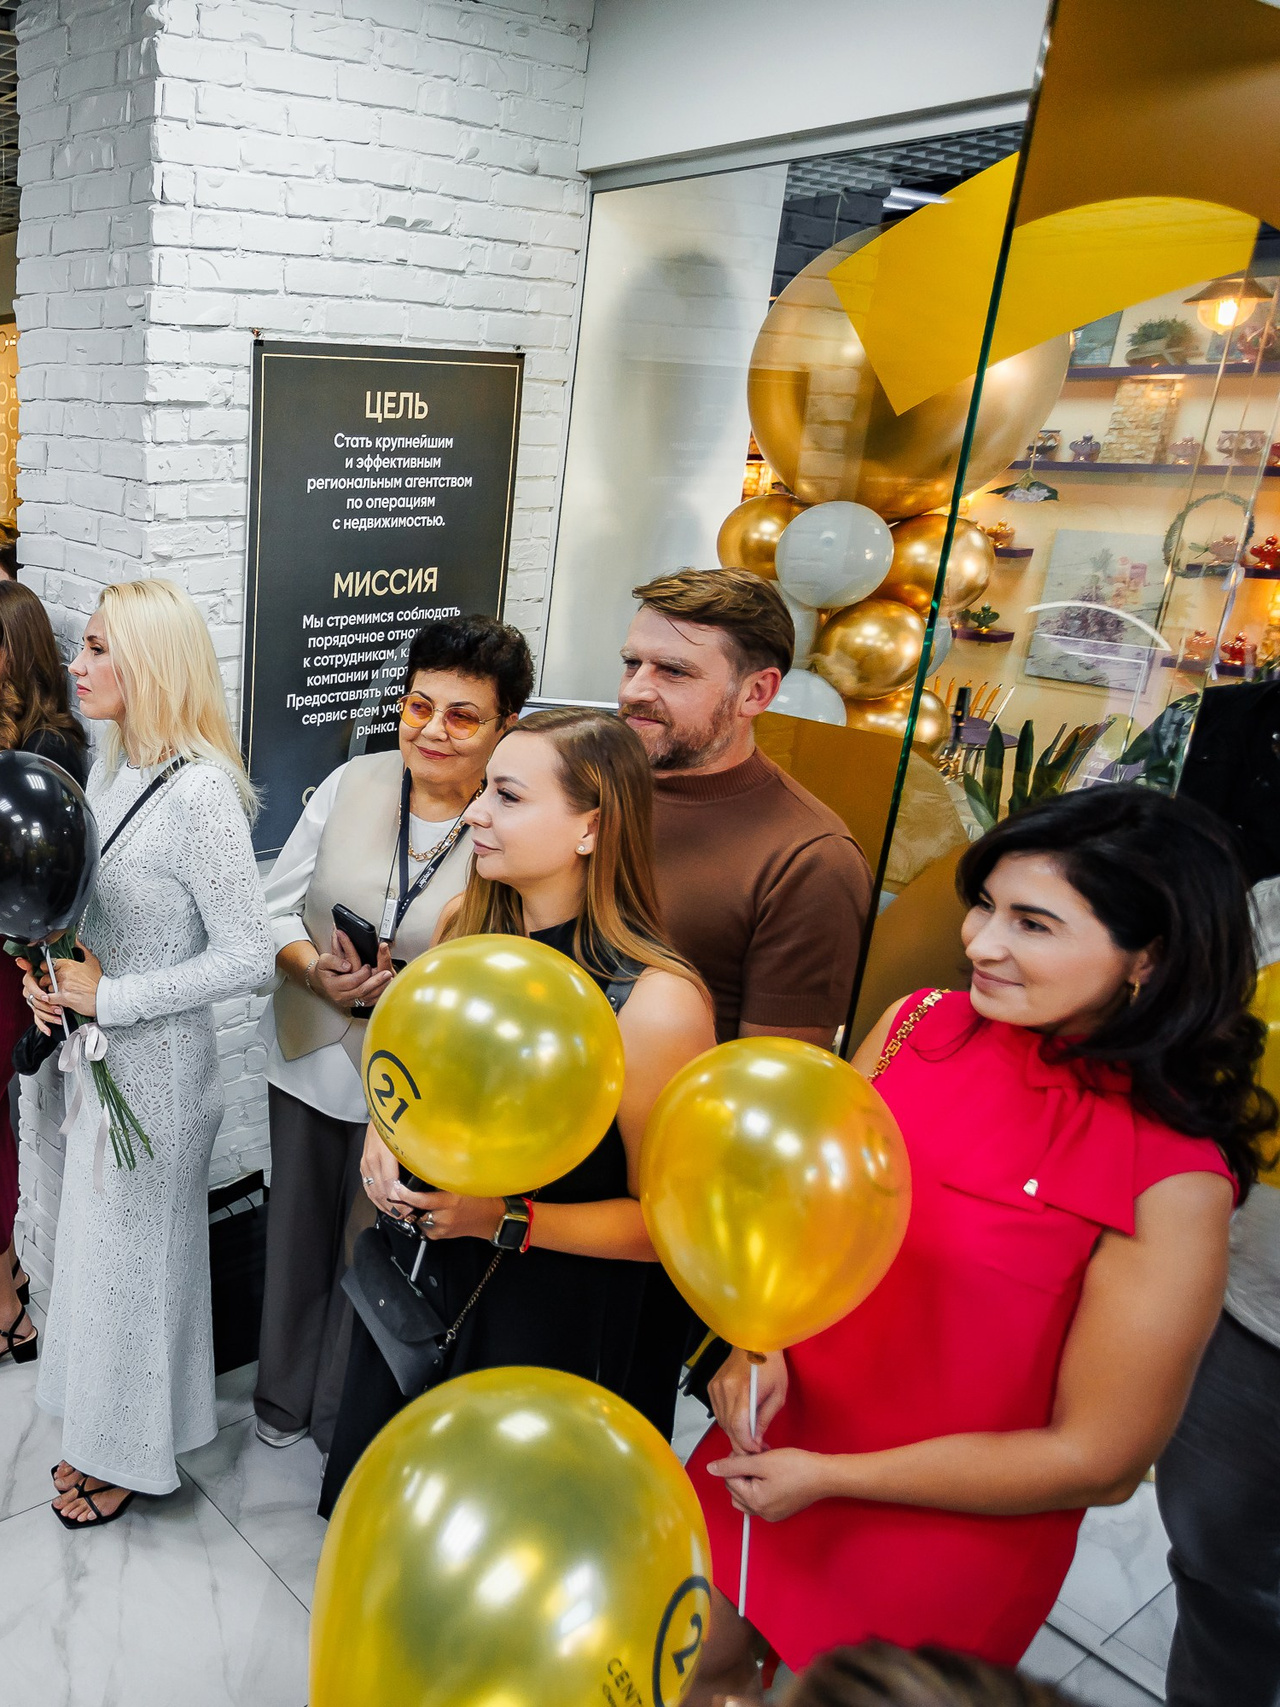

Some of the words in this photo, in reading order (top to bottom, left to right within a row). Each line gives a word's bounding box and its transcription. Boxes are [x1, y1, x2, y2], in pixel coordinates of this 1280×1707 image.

[365, 390, 429, 423] ЦЕЛЬ
[334, 432, 372, 449] Стать
[375, 433, 454, 452] крупнейшим
[345, 457, 353, 469] и
[356, 454, 441, 472] эффективным
[307, 475, 402, 493] региональным
[405, 476, 472, 489] агентством
[346, 497, 363, 510] по
[365, 495, 436, 513] операциям
[332, 517, 341, 530] с
[344, 513, 446, 532] недвижимостью.
[333, 567, 439, 598] МИССИЯ
[302, 614, 324, 629] Мы
[326, 610, 394, 630] стремимся
[396, 606, 461, 621] соблюдать
[308, 631, 385, 650] порядочное
[303, 657, 311, 668] к
[313, 649, 398, 668] сотрудникам,
[306, 670, 369, 687] компании
[371, 669, 379, 680] и
[286, 687, 381, 711] Предоставлять
[301, 709, 348, 727] сервис
[350, 705, 379, 719] всем
[356, 721, 398, 739] рынка.
[373, 1073, 410, 1124] 21
